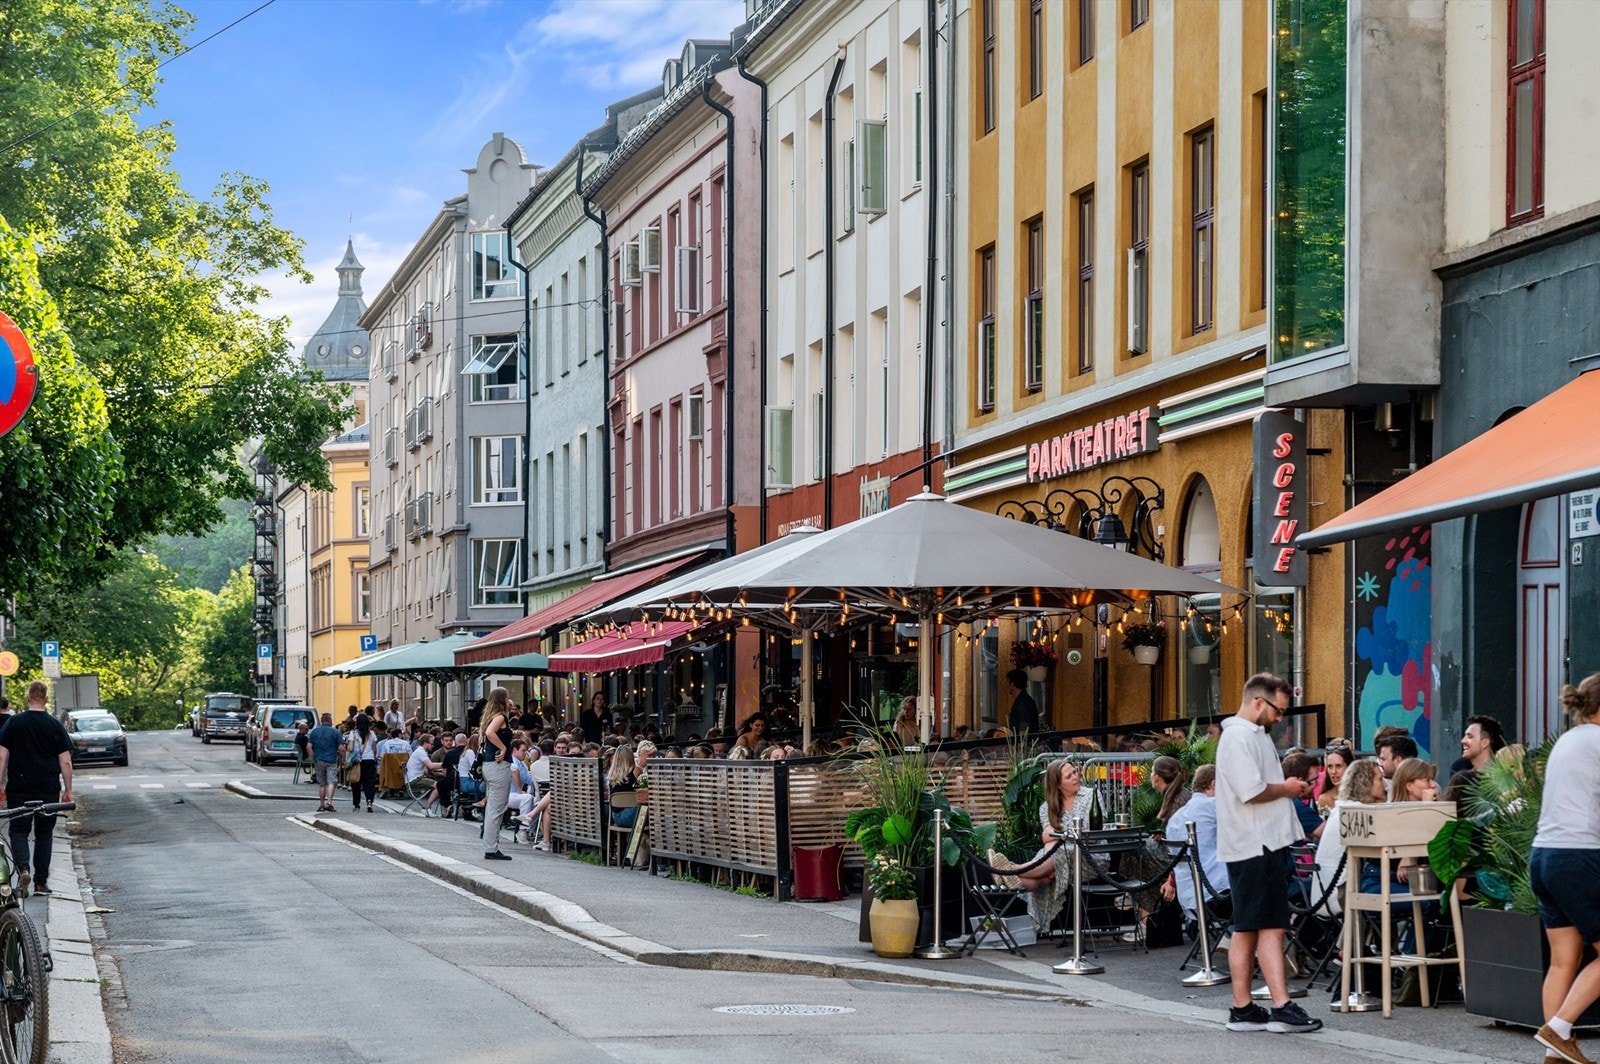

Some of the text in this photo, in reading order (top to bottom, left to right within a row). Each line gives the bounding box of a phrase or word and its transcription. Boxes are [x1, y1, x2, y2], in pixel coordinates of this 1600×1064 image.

[1028, 406, 1150, 483] PARKTEATRET
[1270, 432, 1298, 572] SCENE
[46, 643, 55, 656] P
[364, 637, 373, 649] P
[260, 646, 269, 656] P
